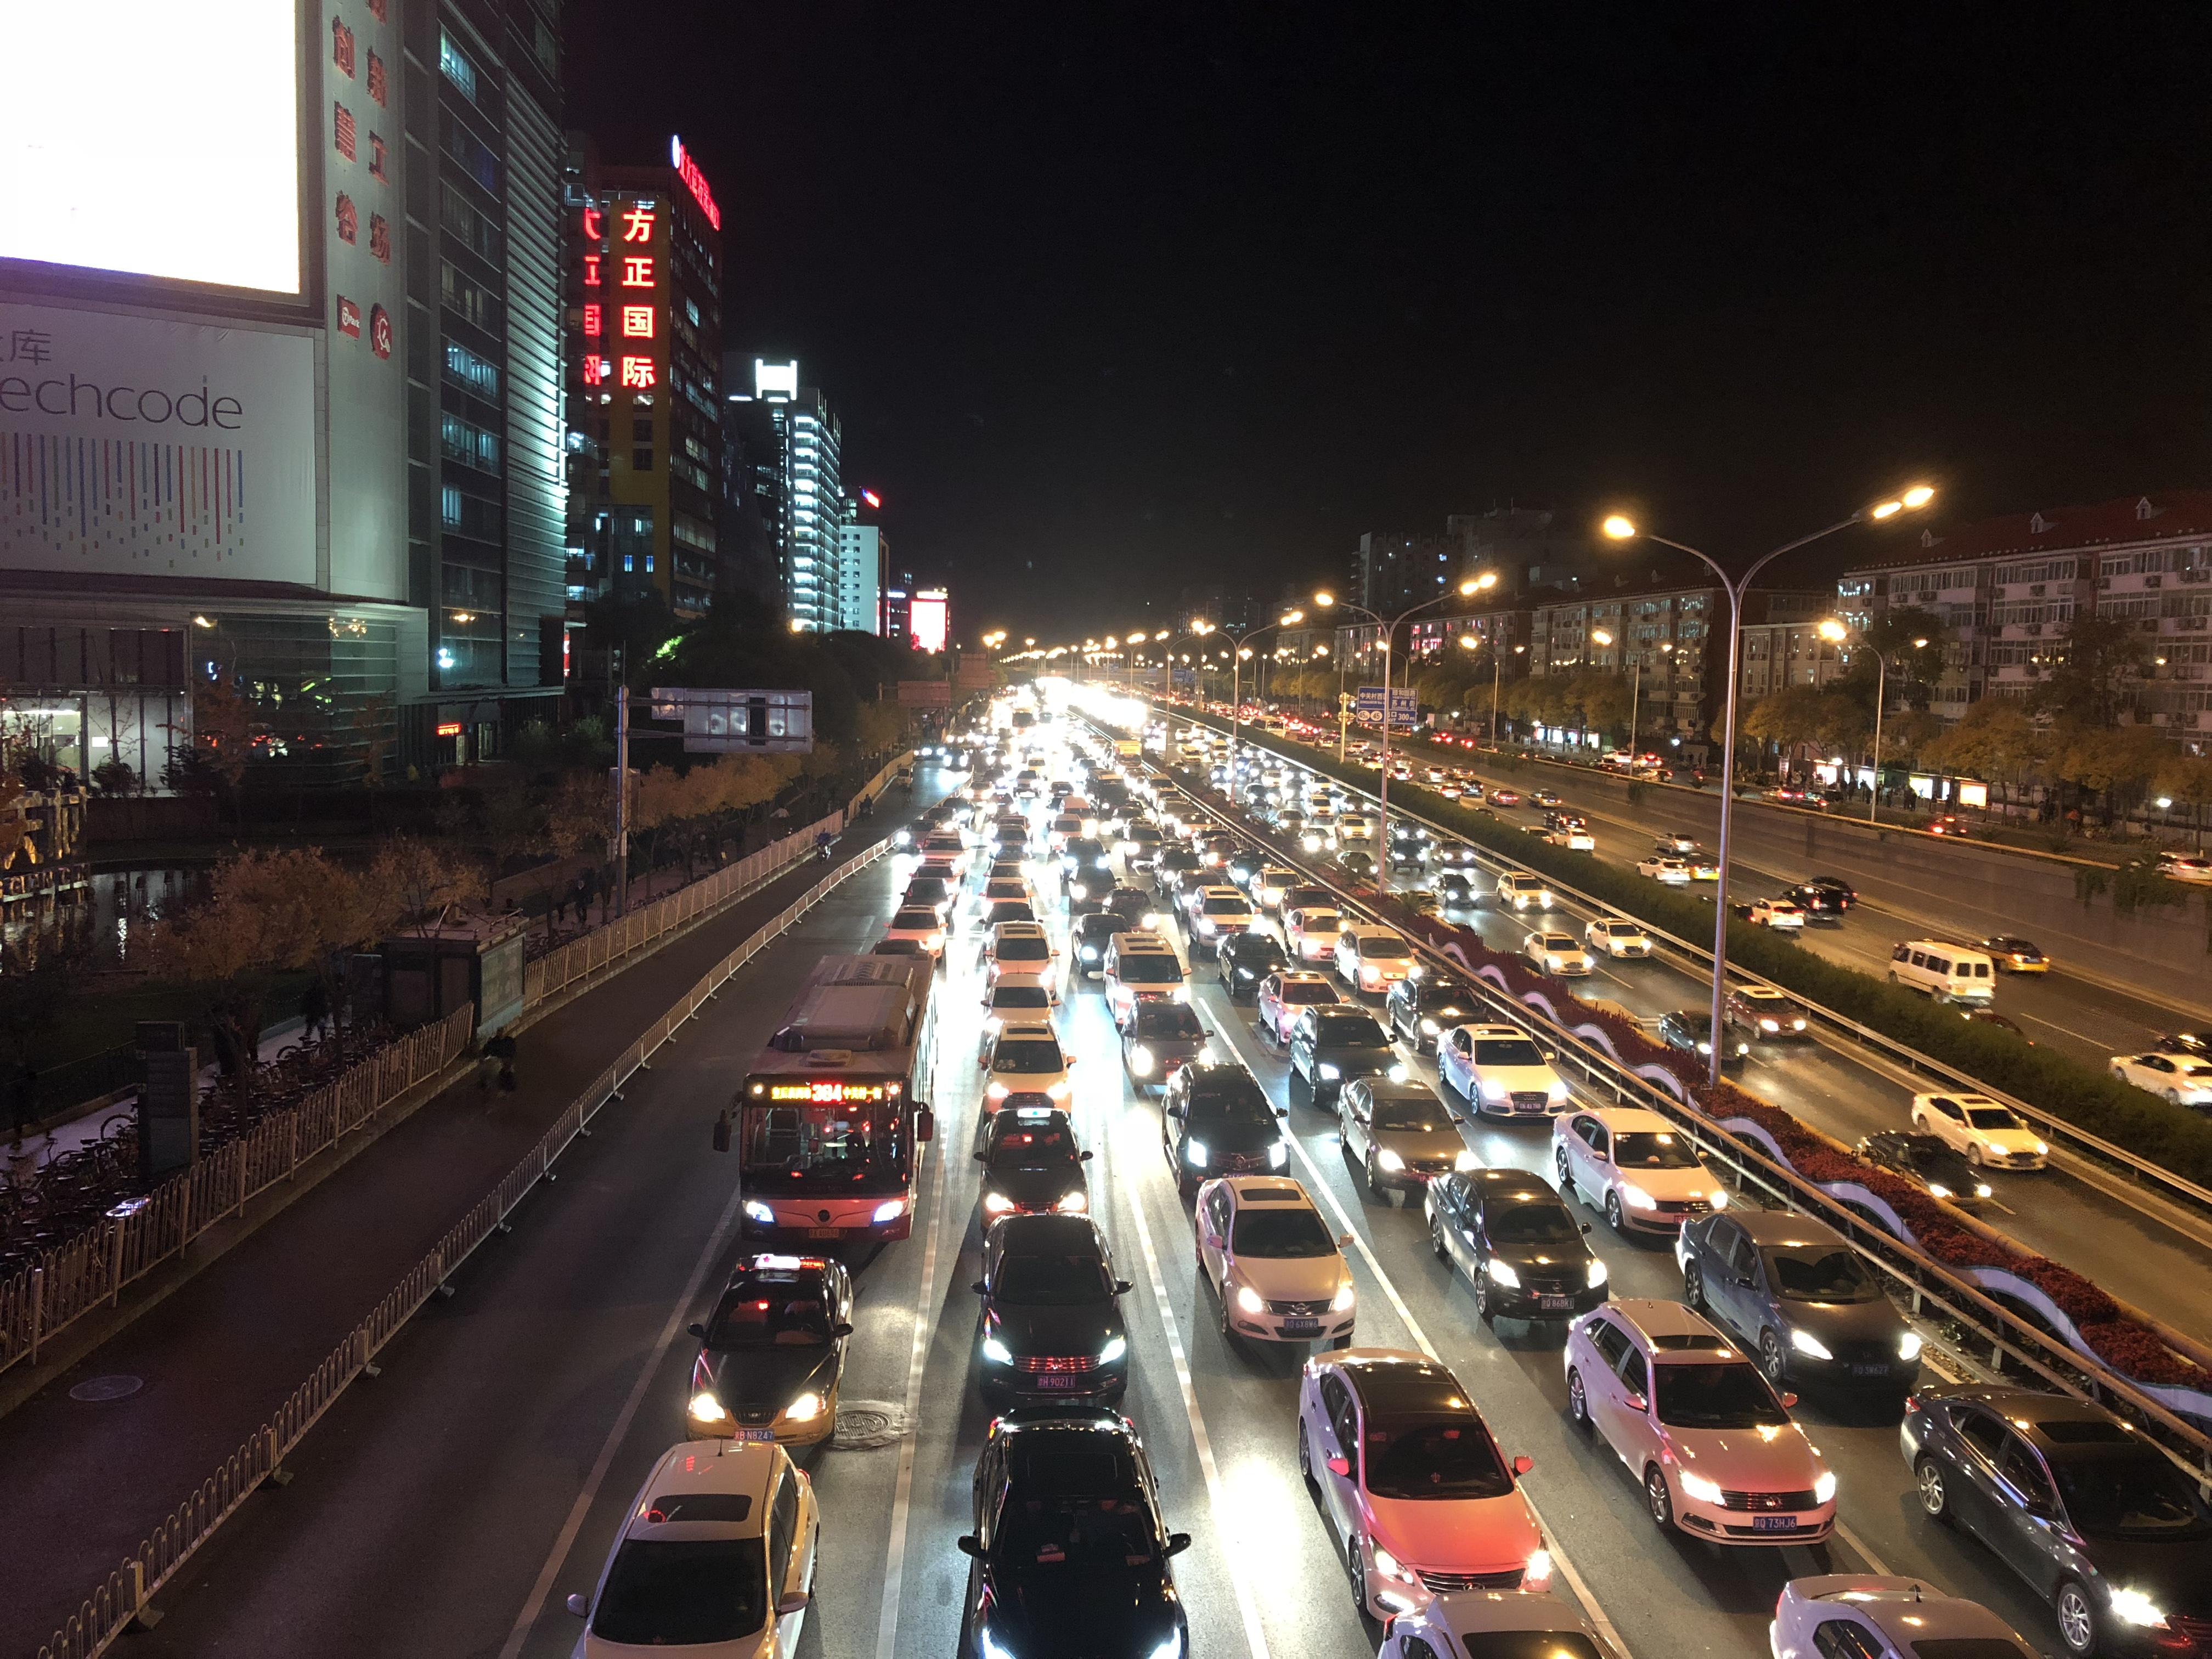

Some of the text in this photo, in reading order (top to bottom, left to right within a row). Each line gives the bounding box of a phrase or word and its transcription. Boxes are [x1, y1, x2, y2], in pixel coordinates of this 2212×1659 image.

[0, 329, 52, 366] 库
[622, 208, 656, 388] 方正国际
